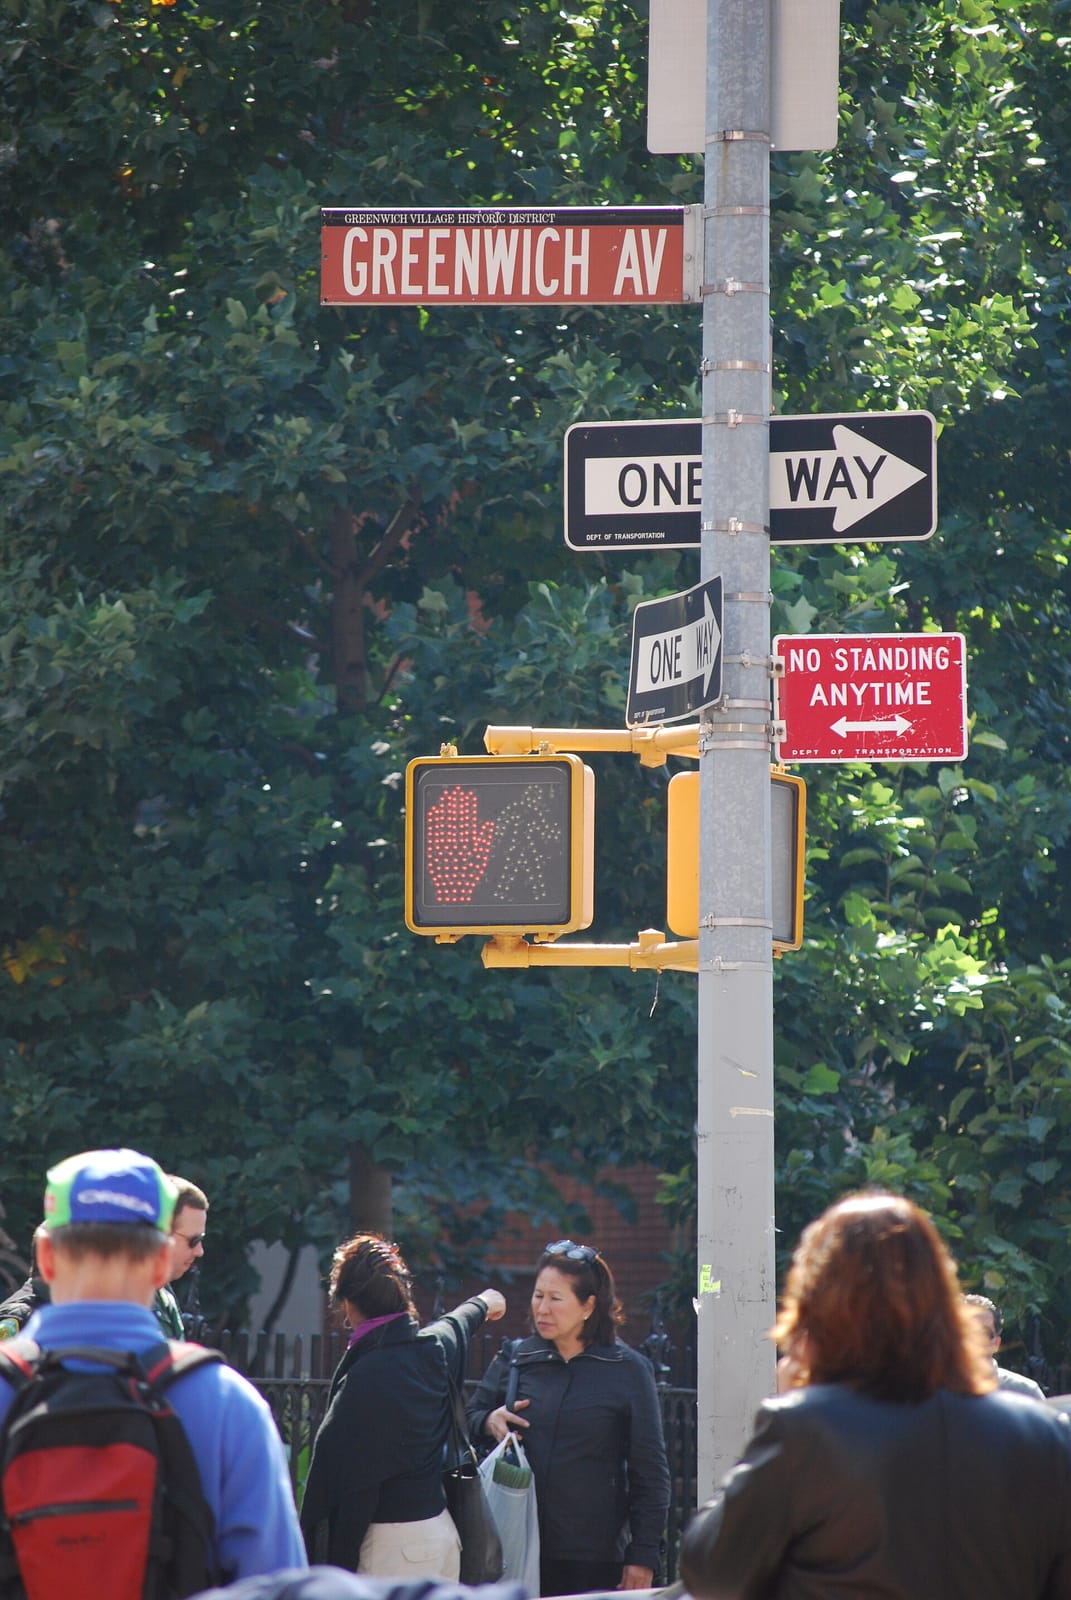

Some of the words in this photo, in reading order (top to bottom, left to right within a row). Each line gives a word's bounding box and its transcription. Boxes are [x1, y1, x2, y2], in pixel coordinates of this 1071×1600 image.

[344, 213, 408, 224] GREENWICH
[410, 213, 455, 224] VILLAGE
[458, 212, 506, 224] HISTORIC
[508, 212, 556, 223] DISTRICT
[342, 226, 591, 297] GREENWICH
[612, 228, 668, 296] AV
[784, 454, 888, 502] WAY
[604, 533, 613, 541] OF
[614, 531, 665, 540] TRANSPORTATION
[650, 634, 682, 685] ONE
[695, 618, 715, 671] WAY
[789, 648, 821, 673] NO
[834, 646, 950, 672] STANDING
[809, 681, 933, 707] ANYTIME
[855, 747, 953, 755] TRANSPORTATION
